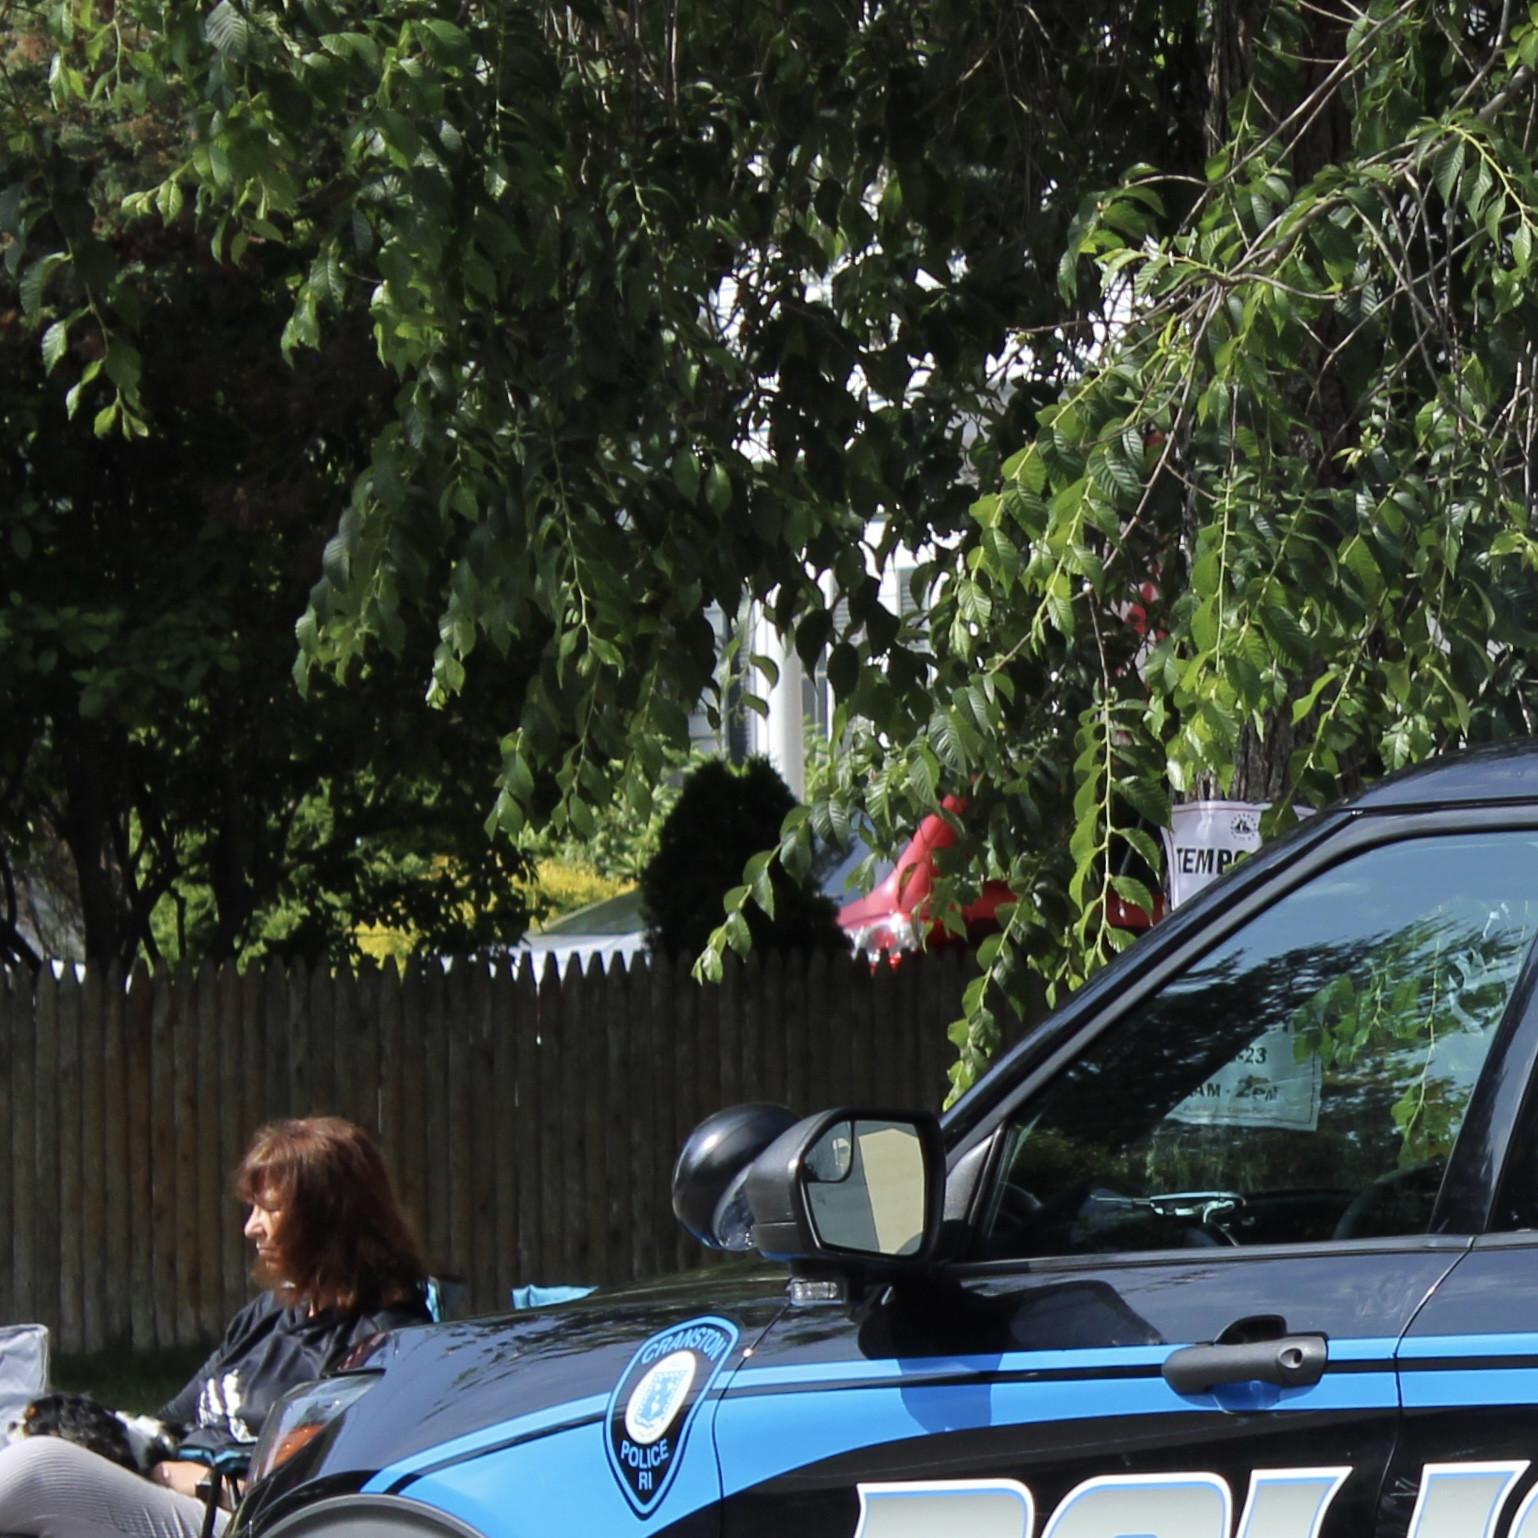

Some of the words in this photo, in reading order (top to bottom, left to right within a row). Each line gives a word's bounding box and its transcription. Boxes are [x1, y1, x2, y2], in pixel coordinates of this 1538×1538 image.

[641, 1326, 728, 1362] CRANSTON
[620, 1438, 670, 1469] POLICE
[638, 1470, 653, 1491] RI
